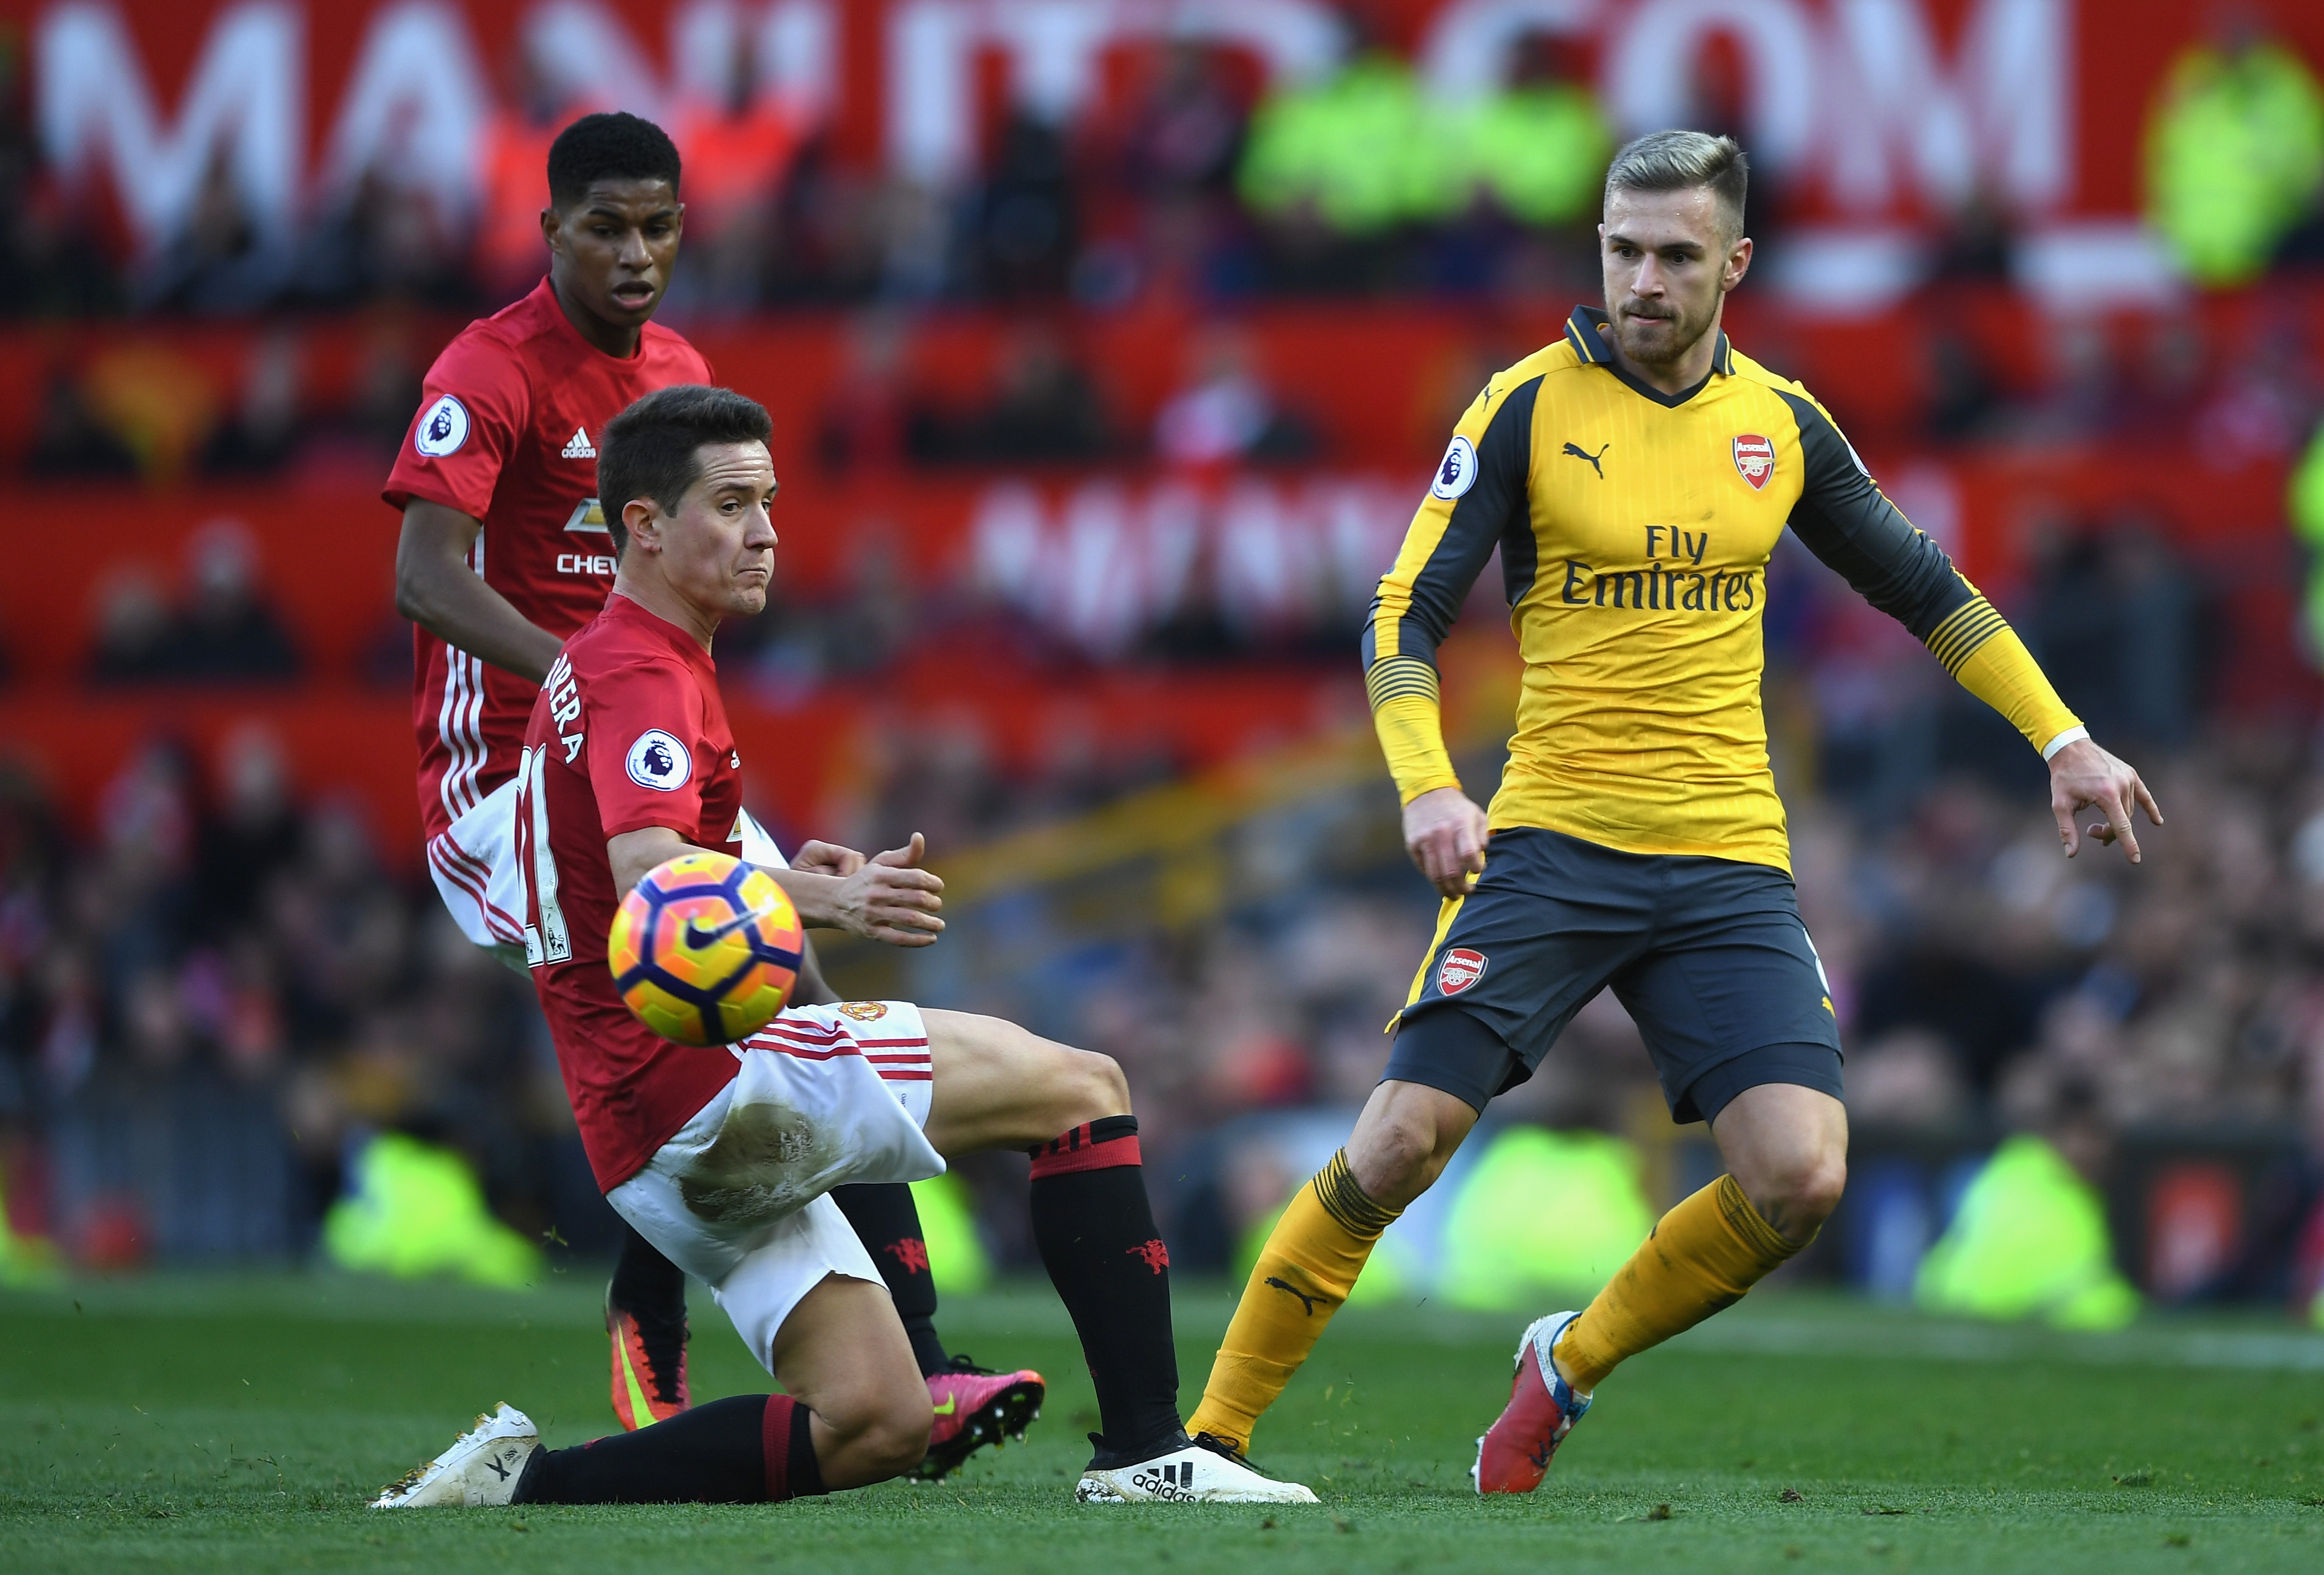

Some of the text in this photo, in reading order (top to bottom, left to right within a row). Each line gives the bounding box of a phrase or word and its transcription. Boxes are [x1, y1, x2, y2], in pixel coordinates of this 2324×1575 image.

[561, 447, 596, 458] adidas
[1737, 442, 1770, 453] Arsenal
[1645, 524, 1708, 565] Fly
[1562, 559, 1754, 612] Emirates
[1447, 955, 1482, 969] Arsenal
[1132, 1474, 1196, 1502] adidas
